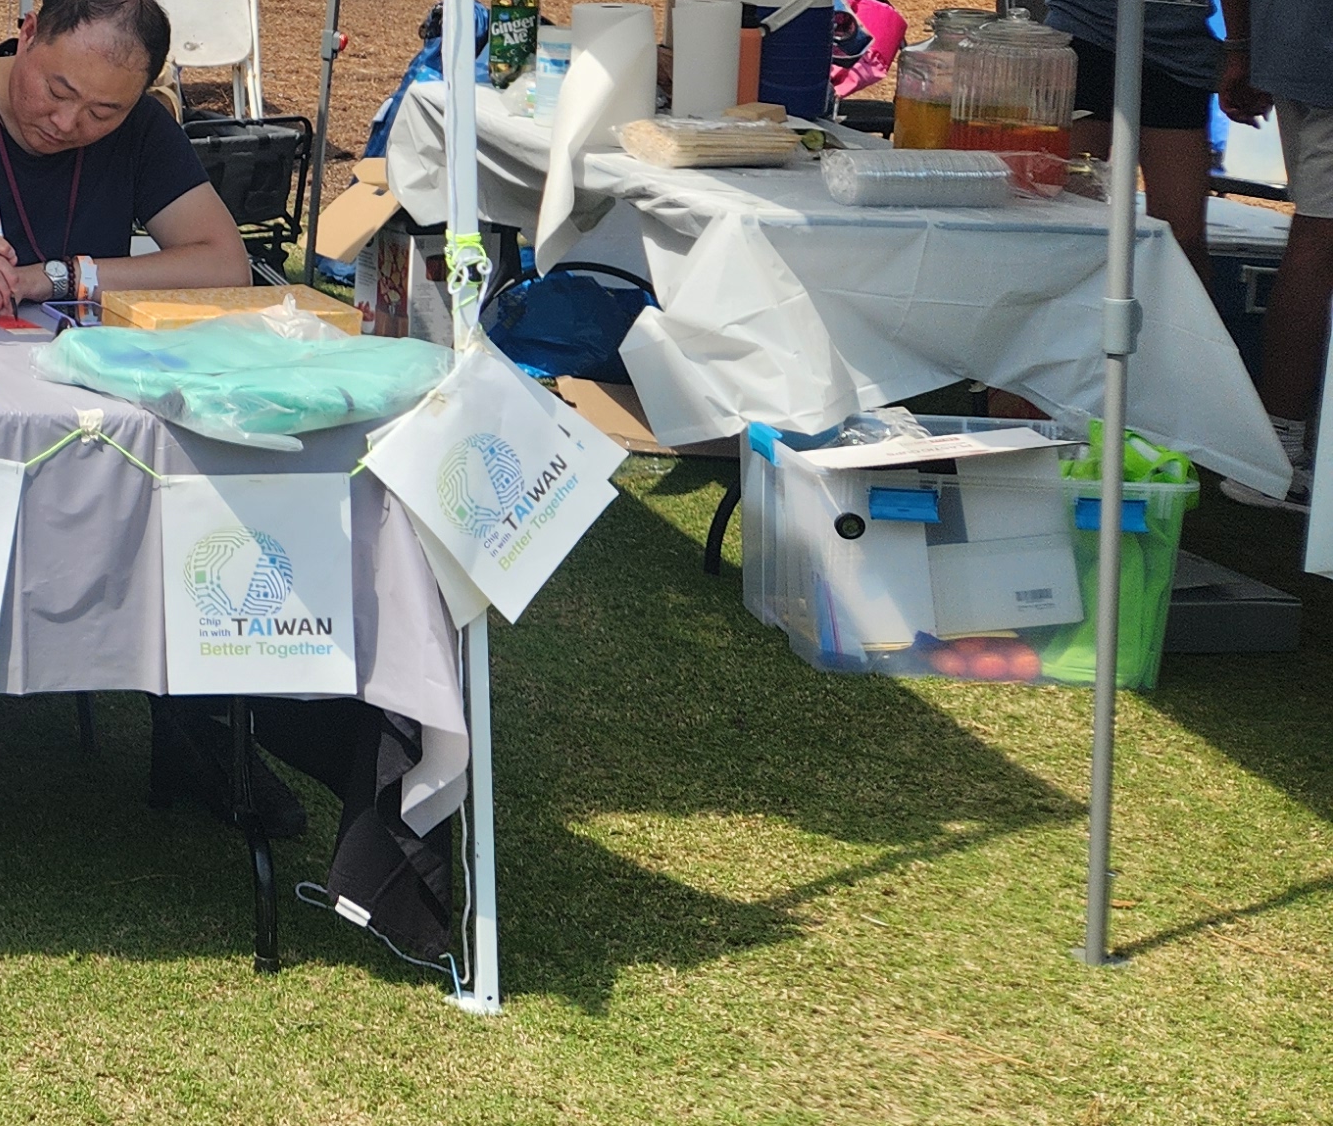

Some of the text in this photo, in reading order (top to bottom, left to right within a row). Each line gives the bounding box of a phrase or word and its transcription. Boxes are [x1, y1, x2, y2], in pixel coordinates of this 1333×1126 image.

[491, 14, 536, 36] Ginger
[503, 30, 528, 46] Ale
[502, 454, 568, 531] TAIWAN
[498, 529, 534, 572] Better
[530, 473, 579, 529] Together
[483, 530, 500, 549] Chip
[490, 531, 512, 558] in with
[199, 617, 221, 627] Chip
[231, 617, 333, 636] TAIWAN
[199, 629, 231, 637] in with
[200, 641, 333, 658] Better Together
